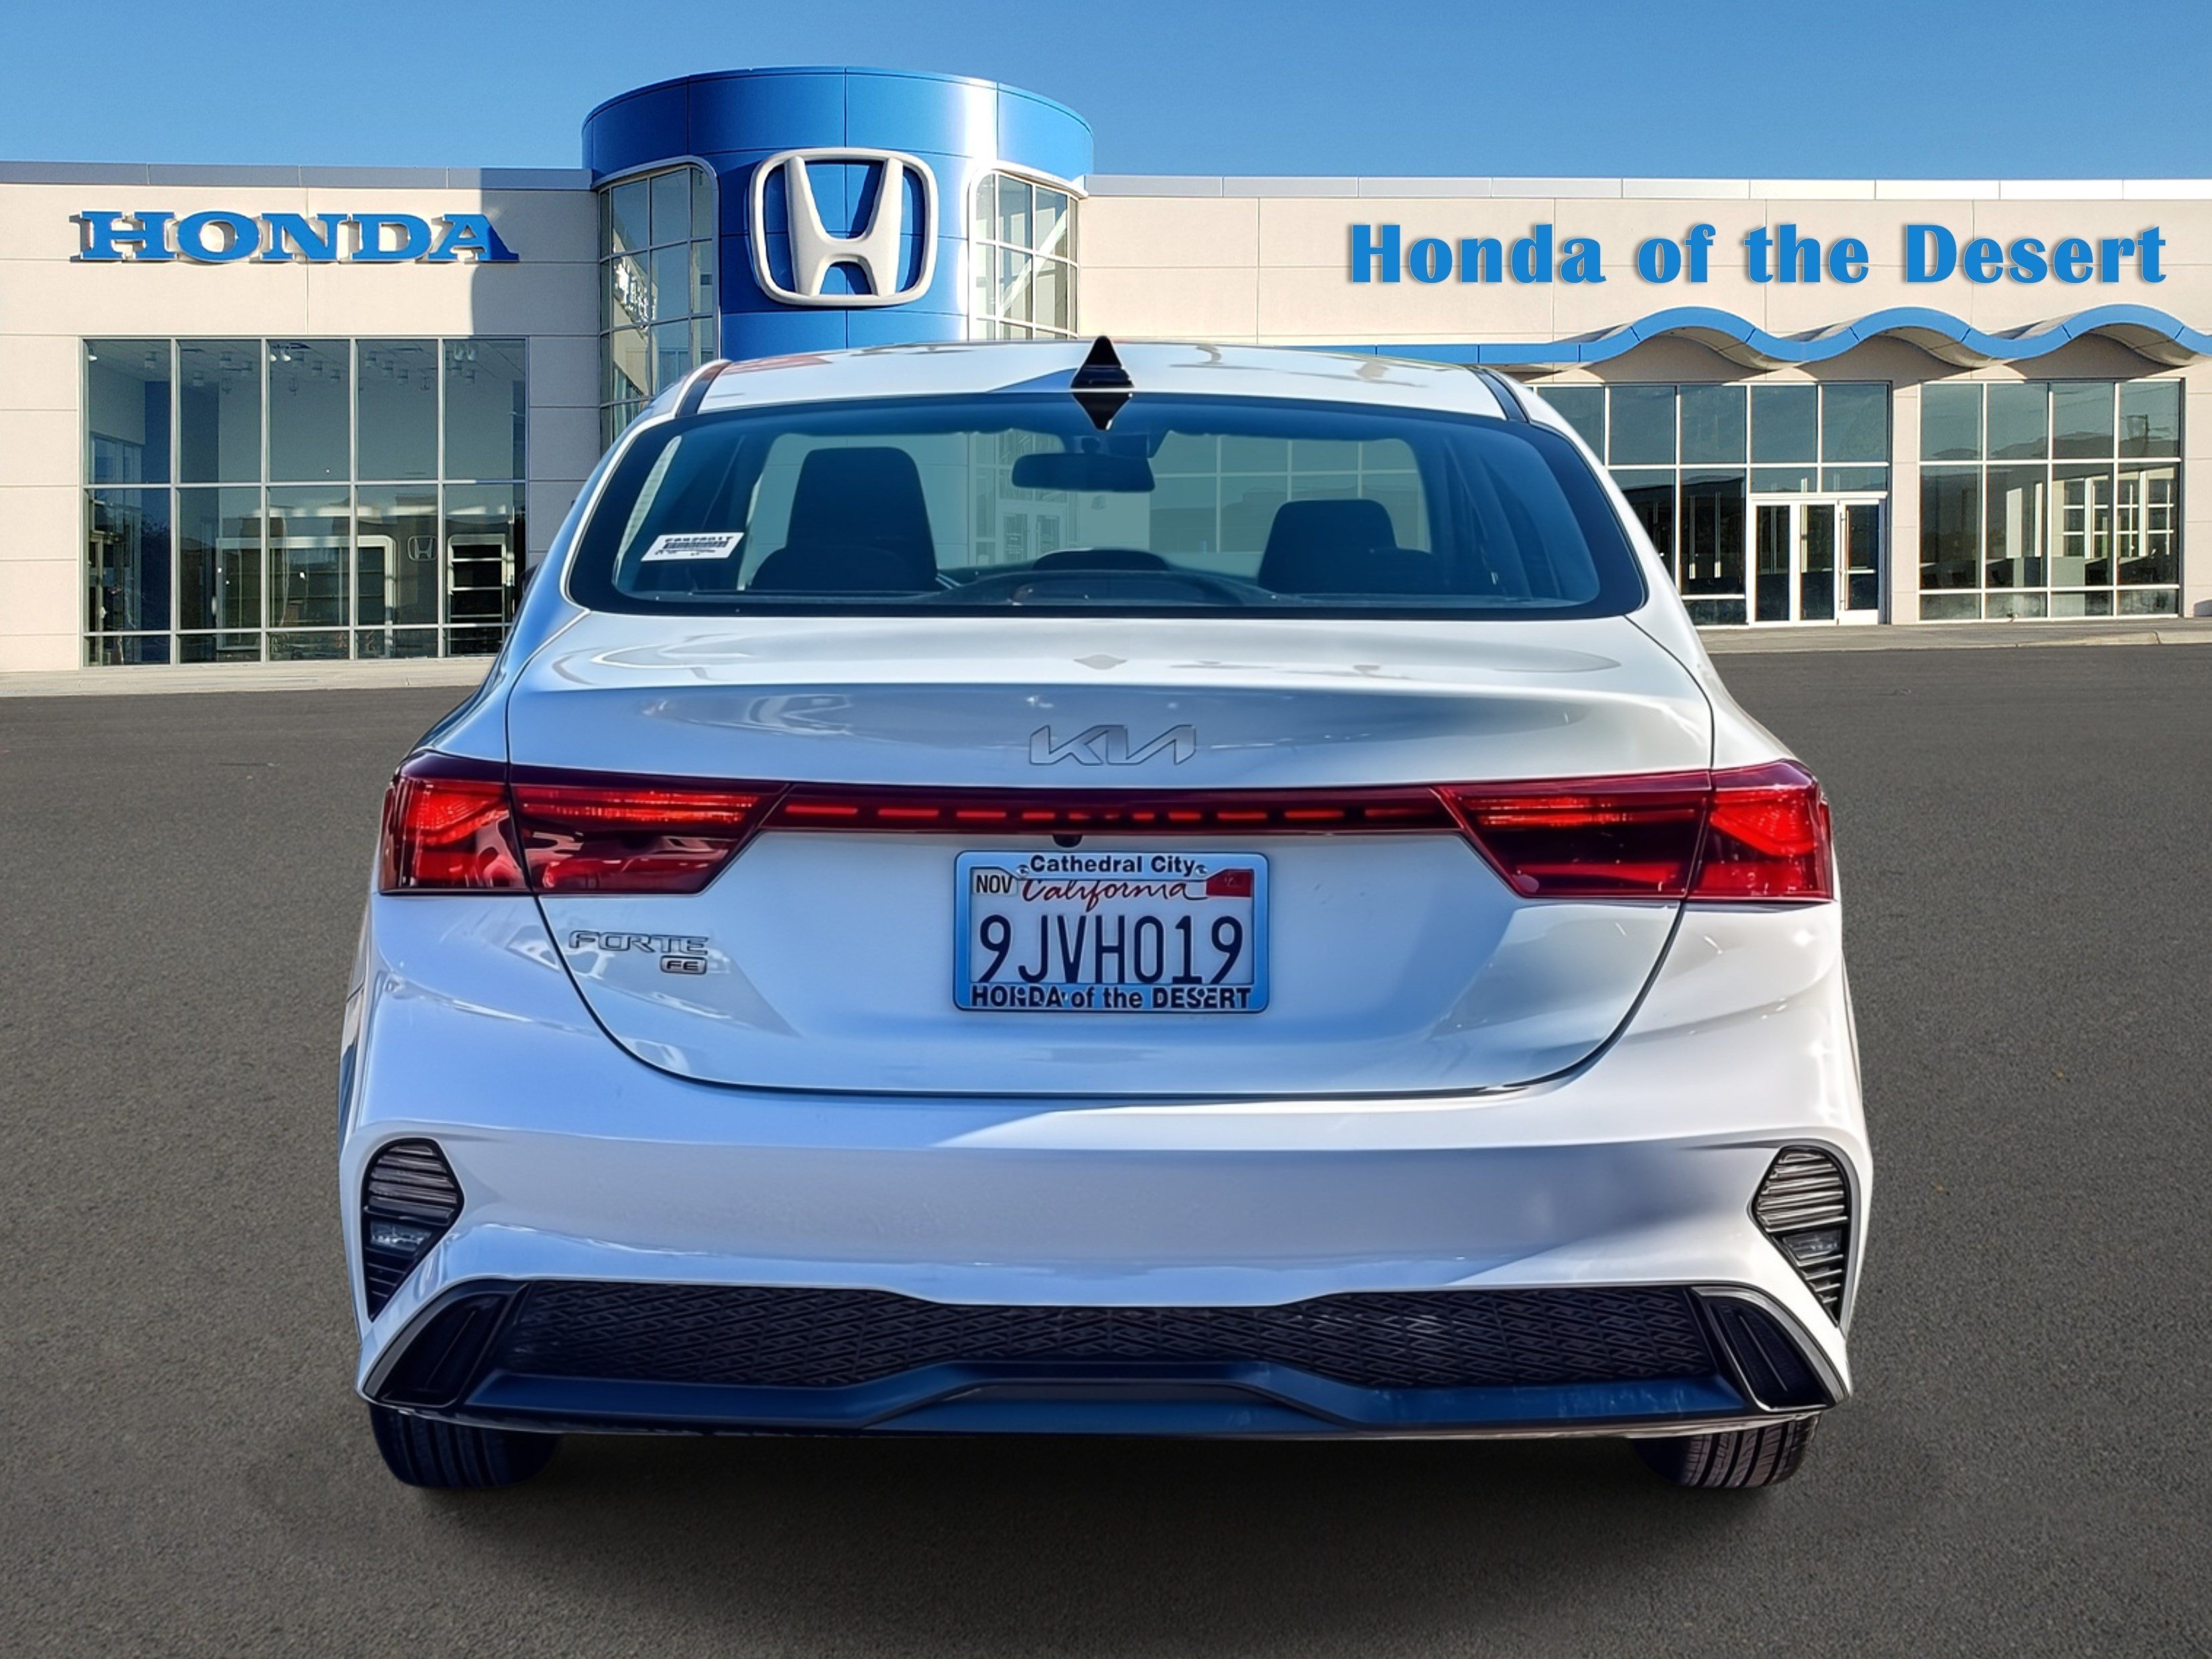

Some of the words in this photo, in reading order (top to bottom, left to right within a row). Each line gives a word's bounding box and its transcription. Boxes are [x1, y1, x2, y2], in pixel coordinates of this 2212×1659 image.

[70, 210, 519, 263] HONDA
[1349, 222, 1607, 284] Honda
[1636, 222, 1717, 284] of
[1743, 222, 1870, 284] the
[1904, 222, 2168, 284] Desert
[1030, 854, 1143, 873] Cathedral
[1151, 855, 1196, 877] City
[975, 875, 1013, 894] NOV
[1022, 879, 1208, 912] California
[569, 930, 709, 956] FORTE
[979, 915, 1243, 983] 9JVH019
[666, 960, 700, 971] FE
[1070, 987, 1096, 1007] of
[1104, 987, 1143, 1008] the
[1152, 988, 1251, 1008] DESERT
